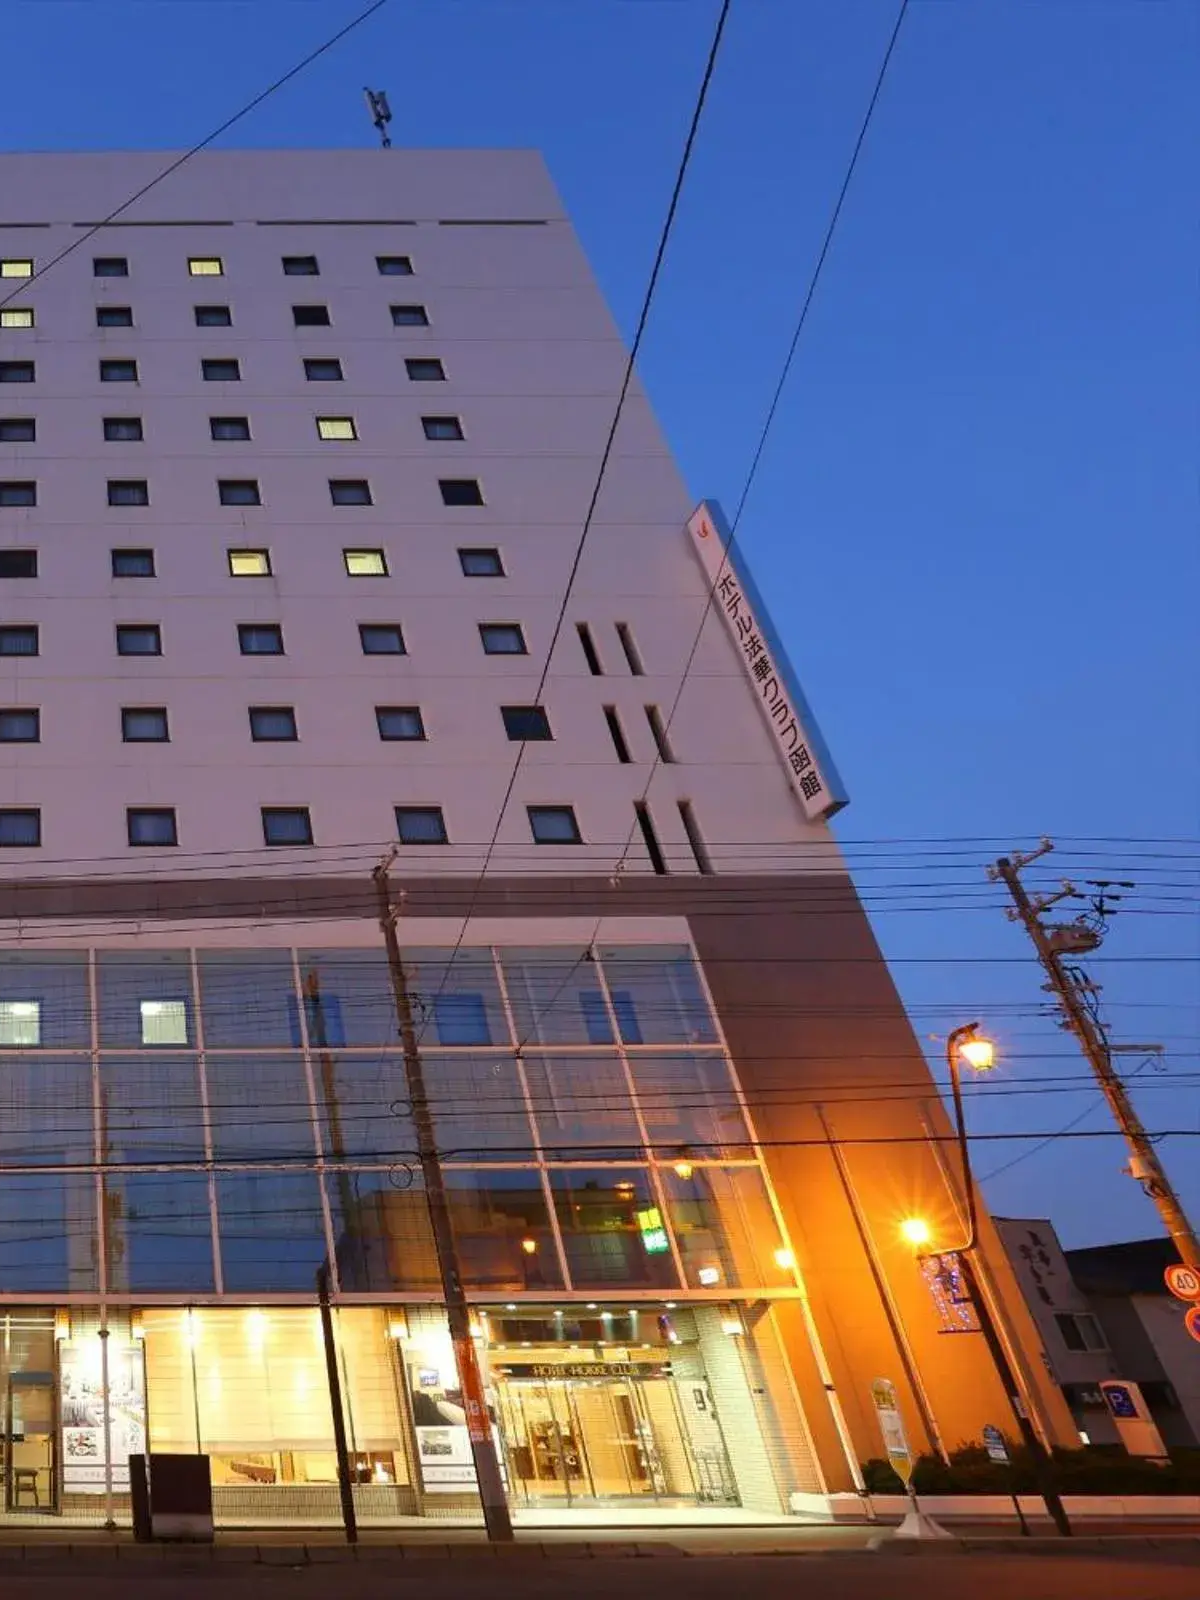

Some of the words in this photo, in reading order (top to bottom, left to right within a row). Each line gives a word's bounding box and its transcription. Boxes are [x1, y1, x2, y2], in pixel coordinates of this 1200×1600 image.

[719, 574, 822, 801] ホテル法華クラブ函館
[1177, 1273, 1196, 1289] 40
